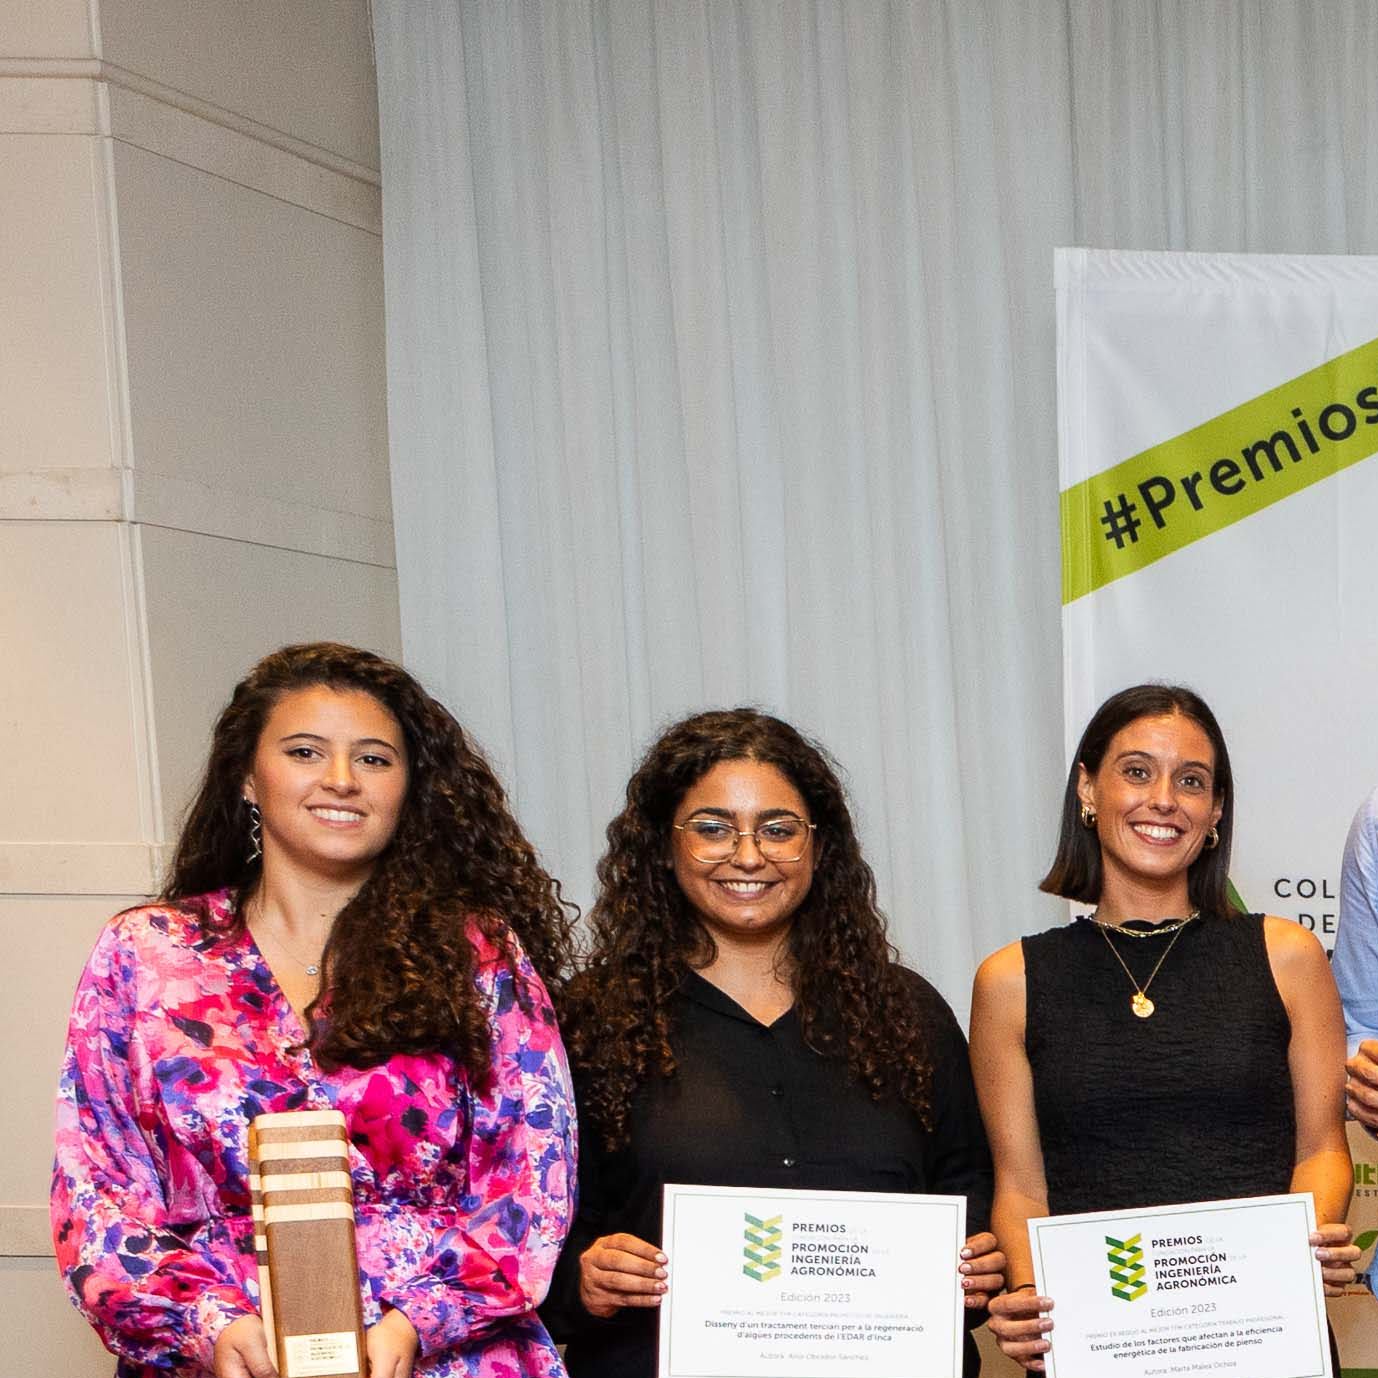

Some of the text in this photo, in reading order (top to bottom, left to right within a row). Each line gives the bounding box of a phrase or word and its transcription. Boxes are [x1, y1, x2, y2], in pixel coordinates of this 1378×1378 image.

[792, 1223, 846, 1234] PREMIOS
[791, 1242, 869, 1254] PROMOCIÓN
[1151, 1235, 1203, 1249] PREMIOS
[791, 1253, 861, 1265] INGENIERÍA
[1154, 1252, 1227, 1268] PROMOCIÓN
[790, 1265, 876, 1277] AGRONÓMICA
[1155, 1264, 1221, 1279] INGENIERÍA
[1156, 1275, 1238, 1291] AGRONÓMICA
[780, 1292, 851, 1303] Edición 2023
[1150, 1302, 1217, 1319] Edición 2023
[1090, 1342, 1121, 1352] Estudio
[1122, 1340, 1133, 1348] de
[1147, 1336, 1180, 1346] factores
[1181, 1335, 1197, 1344] que
[1157, 1346, 1168, 1355] de
[1224, 1340, 1235, 1348] de
